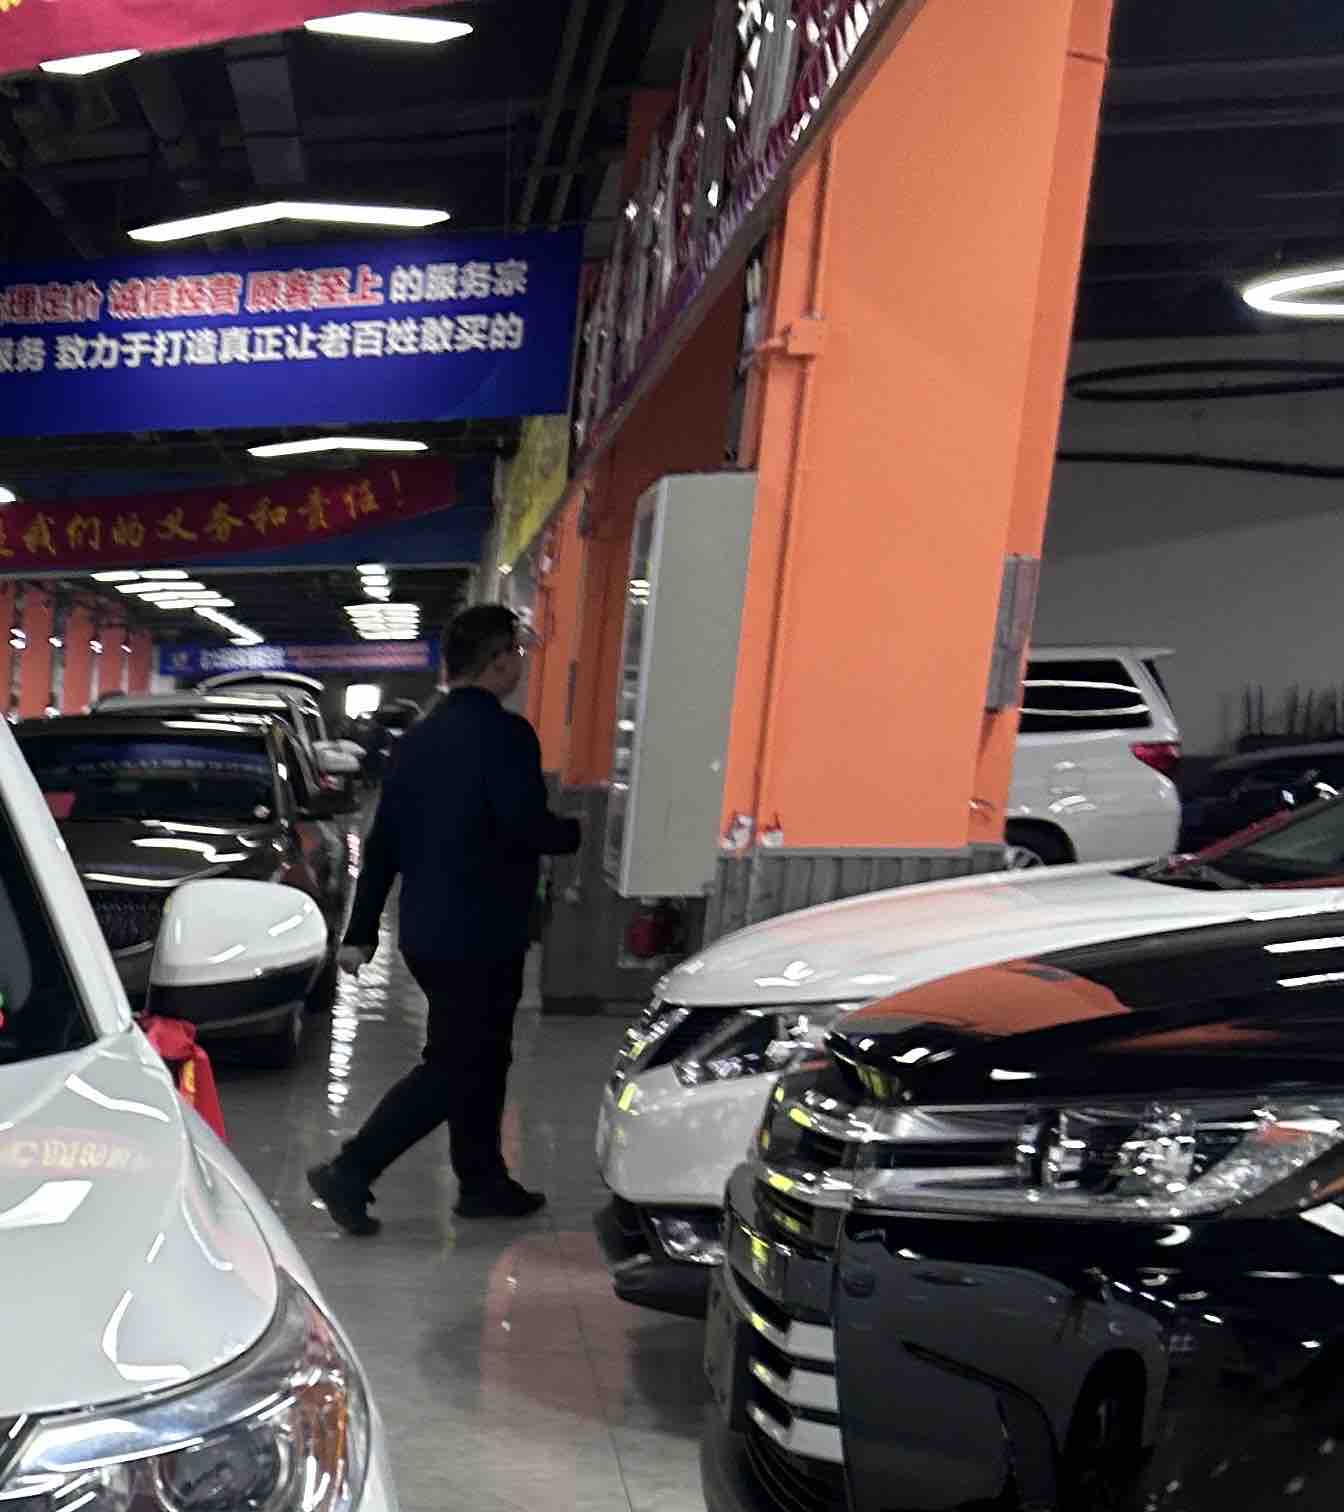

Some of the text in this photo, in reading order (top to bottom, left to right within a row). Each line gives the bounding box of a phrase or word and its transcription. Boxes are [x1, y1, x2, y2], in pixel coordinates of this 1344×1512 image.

[108, 273, 242, 320] 诚信经营
[245, 265, 384, 313] 顾客至上
[390, 260, 528, 303] 的服务宗
[54, 313, 524, 369] 致力于打造真正让老百姓敢买的
